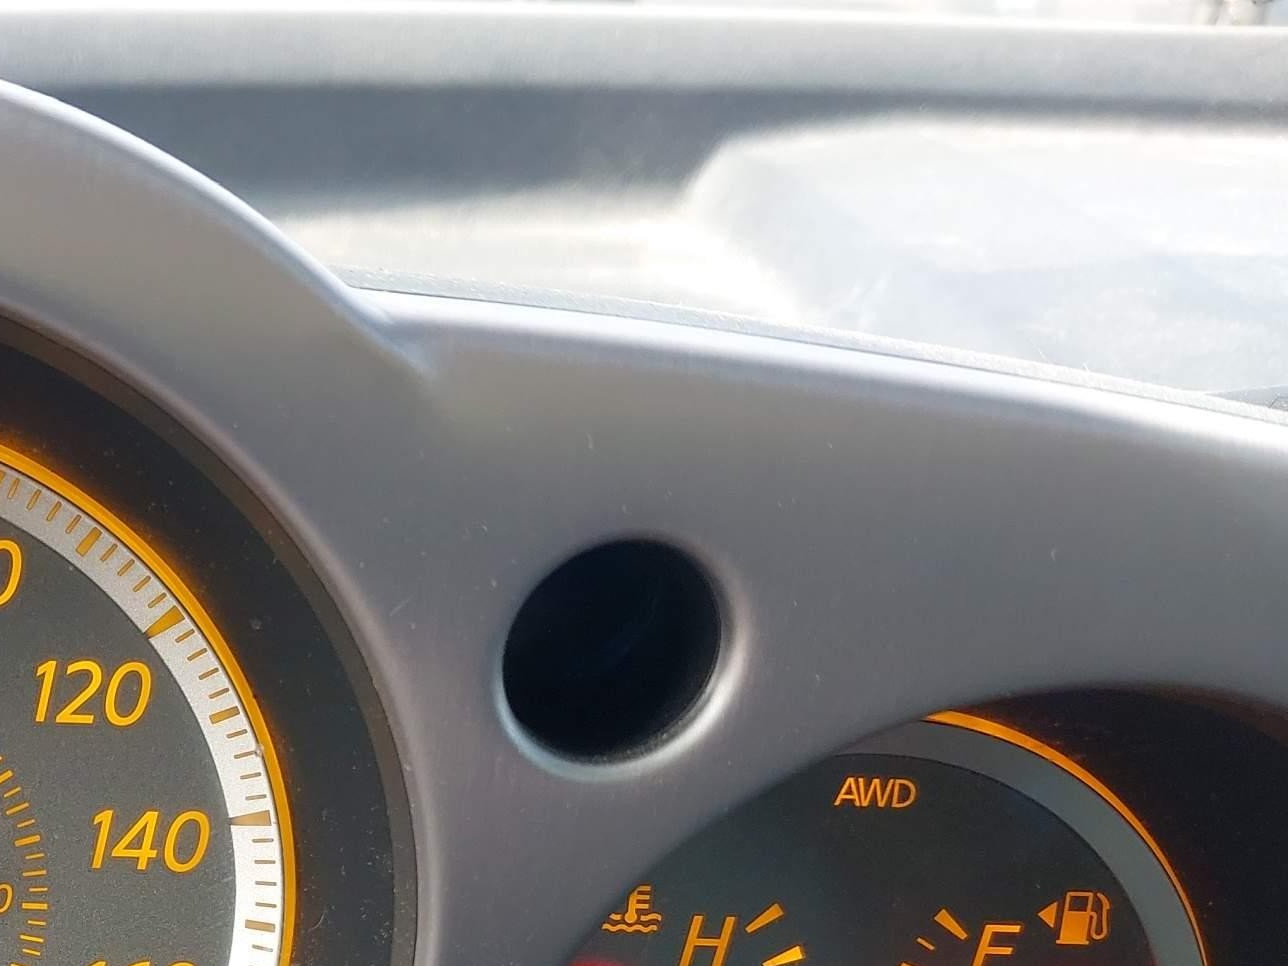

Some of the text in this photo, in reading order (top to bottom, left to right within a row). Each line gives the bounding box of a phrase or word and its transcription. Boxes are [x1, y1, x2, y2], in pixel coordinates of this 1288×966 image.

[34, 659, 153, 727] 120
[835, 777, 916, 808] AWD
[91, 809, 212, 873] 140
